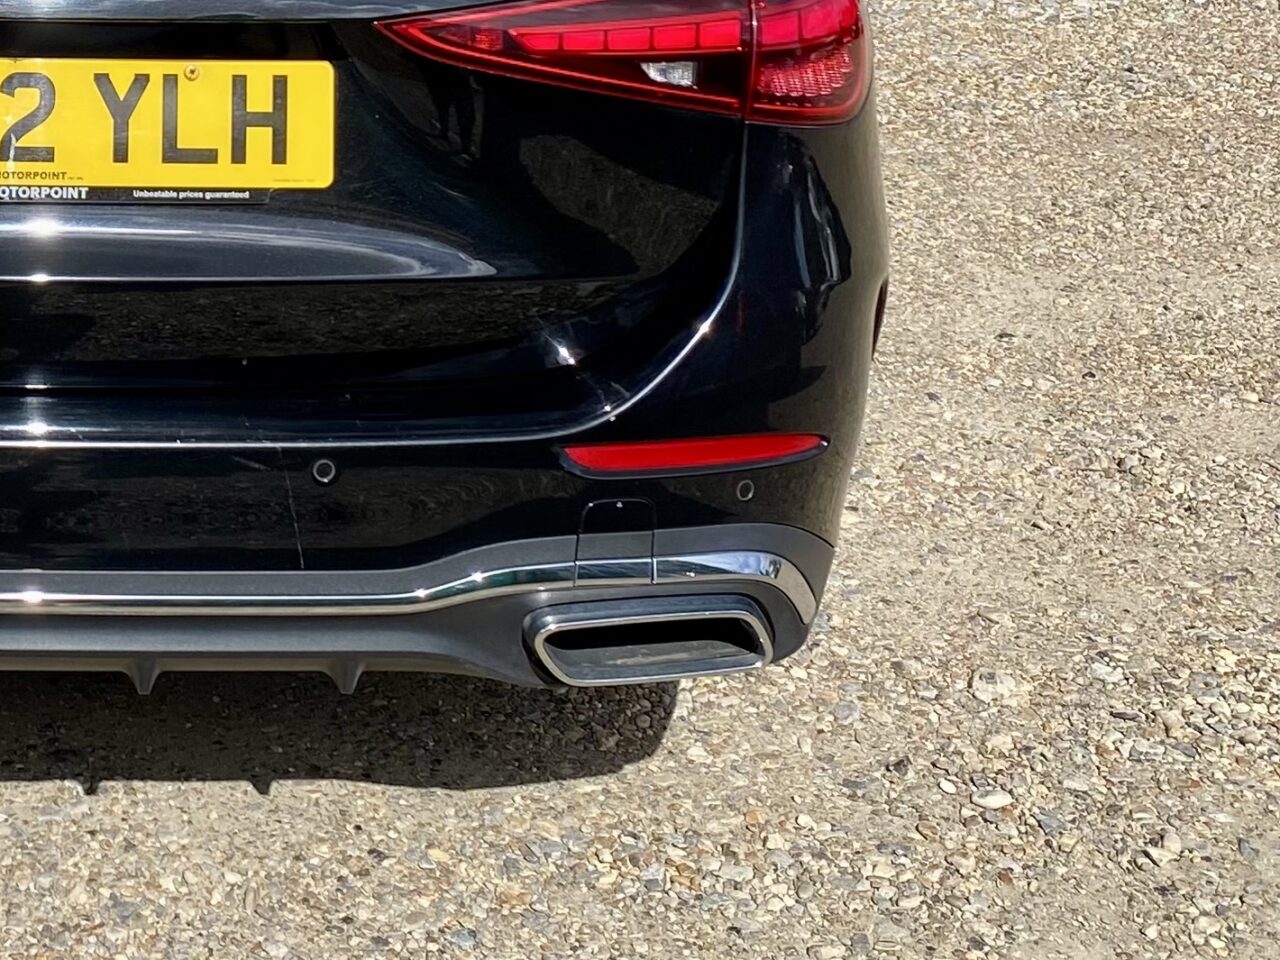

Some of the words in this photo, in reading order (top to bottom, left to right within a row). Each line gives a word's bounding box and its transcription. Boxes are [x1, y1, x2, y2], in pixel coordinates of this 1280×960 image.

[93, 72, 289, 166] YLH
[132, 189, 178, 199] Unbeatable
[178, 191, 204, 201] prices
[205, 191, 250, 200] guaranteed
